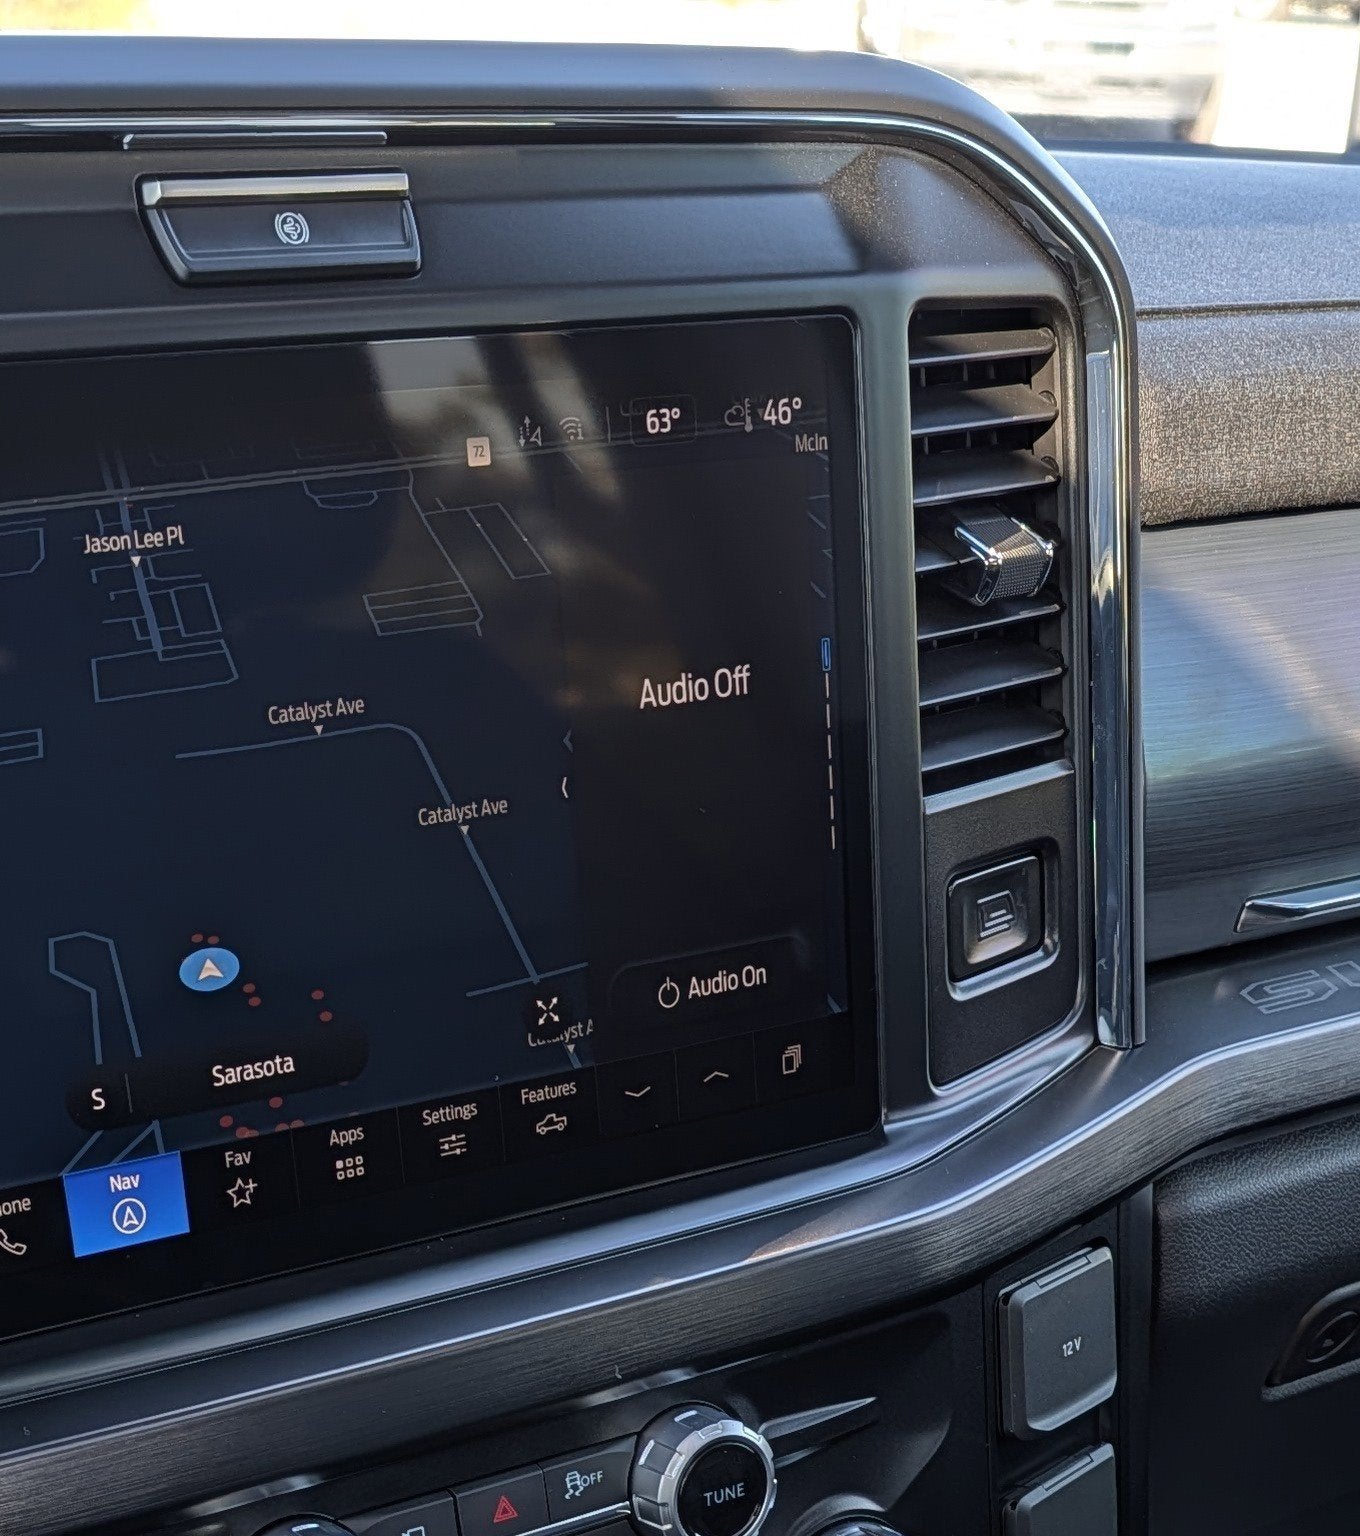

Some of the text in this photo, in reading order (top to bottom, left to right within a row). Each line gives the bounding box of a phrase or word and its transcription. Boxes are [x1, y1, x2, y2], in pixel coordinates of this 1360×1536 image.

[83, 526, 185, 556] Jason Lee Pl
[639, 664, 750, 710] Audio Off
[267, 697, 365, 726] Catalyst Ave
[418, 798, 508, 827] Catalyst Ave
[688, 965, 767, 999] Audio On
[211, 1055, 296, 1087] Sarasota
[92, 1088, 106, 1110] S
[521, 1082, 577, 1105] Features
[422, 1100, 479, 1126] Settings
[329, 1124, 364, 1148] Apps
[224, 1149, 252, 1168] Fav
[109, 1173, 140, 1192] Nav
[580, 1470, 603, 1487] OFF
[703, 1483, 746, 1507] TUNE
